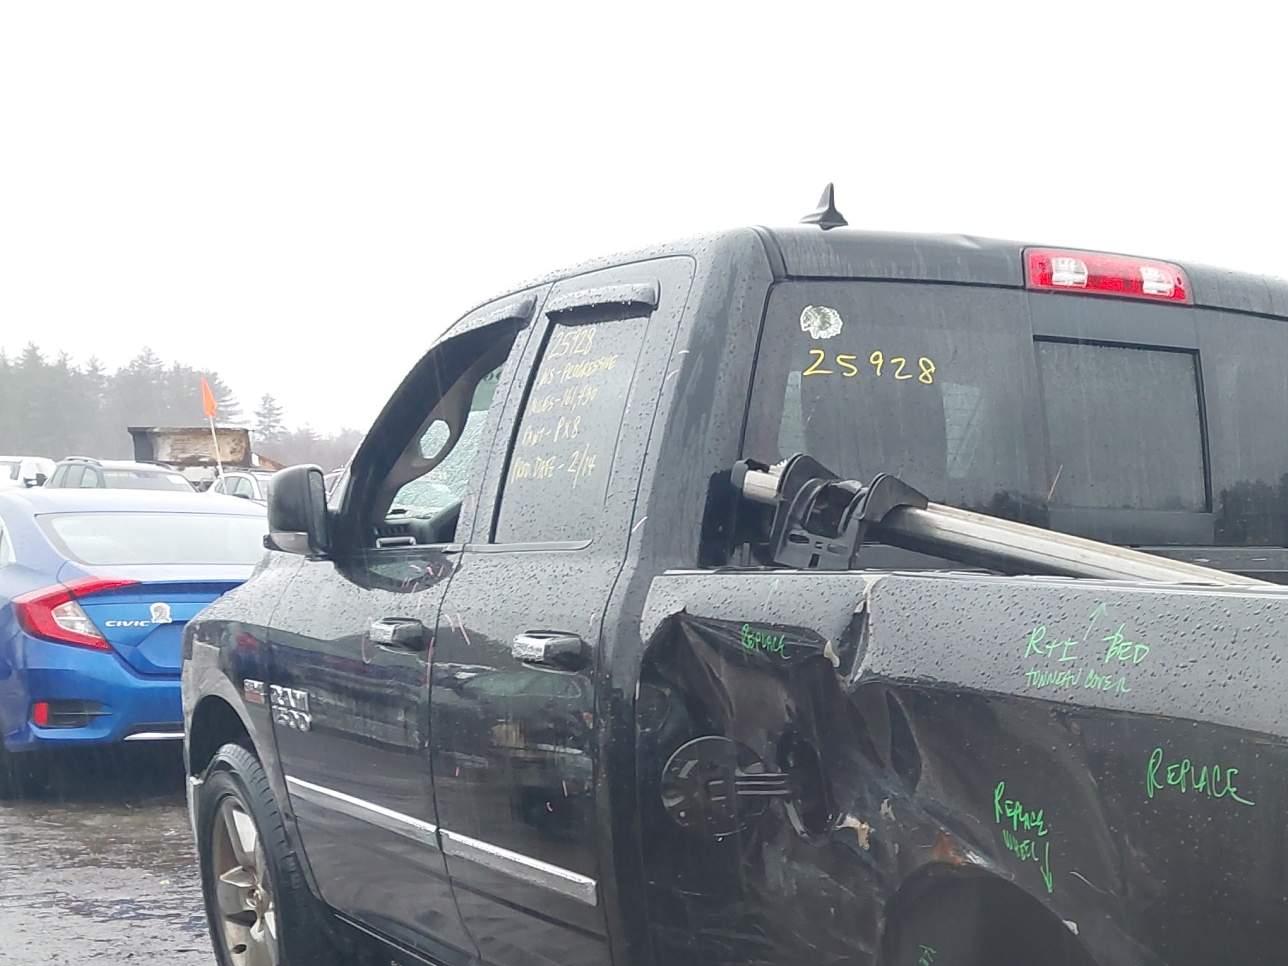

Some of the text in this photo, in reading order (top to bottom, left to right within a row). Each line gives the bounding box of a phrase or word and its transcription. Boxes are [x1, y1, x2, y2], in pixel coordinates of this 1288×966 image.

[803, 349, 936, 384] 25928
[1103, 623, 1149, 663] BED
[1084, 671, 1132, 693] COVER
[1147, 747, 1255, 806] REPLACE
[994, 781, 1048, 836] REPLACE
